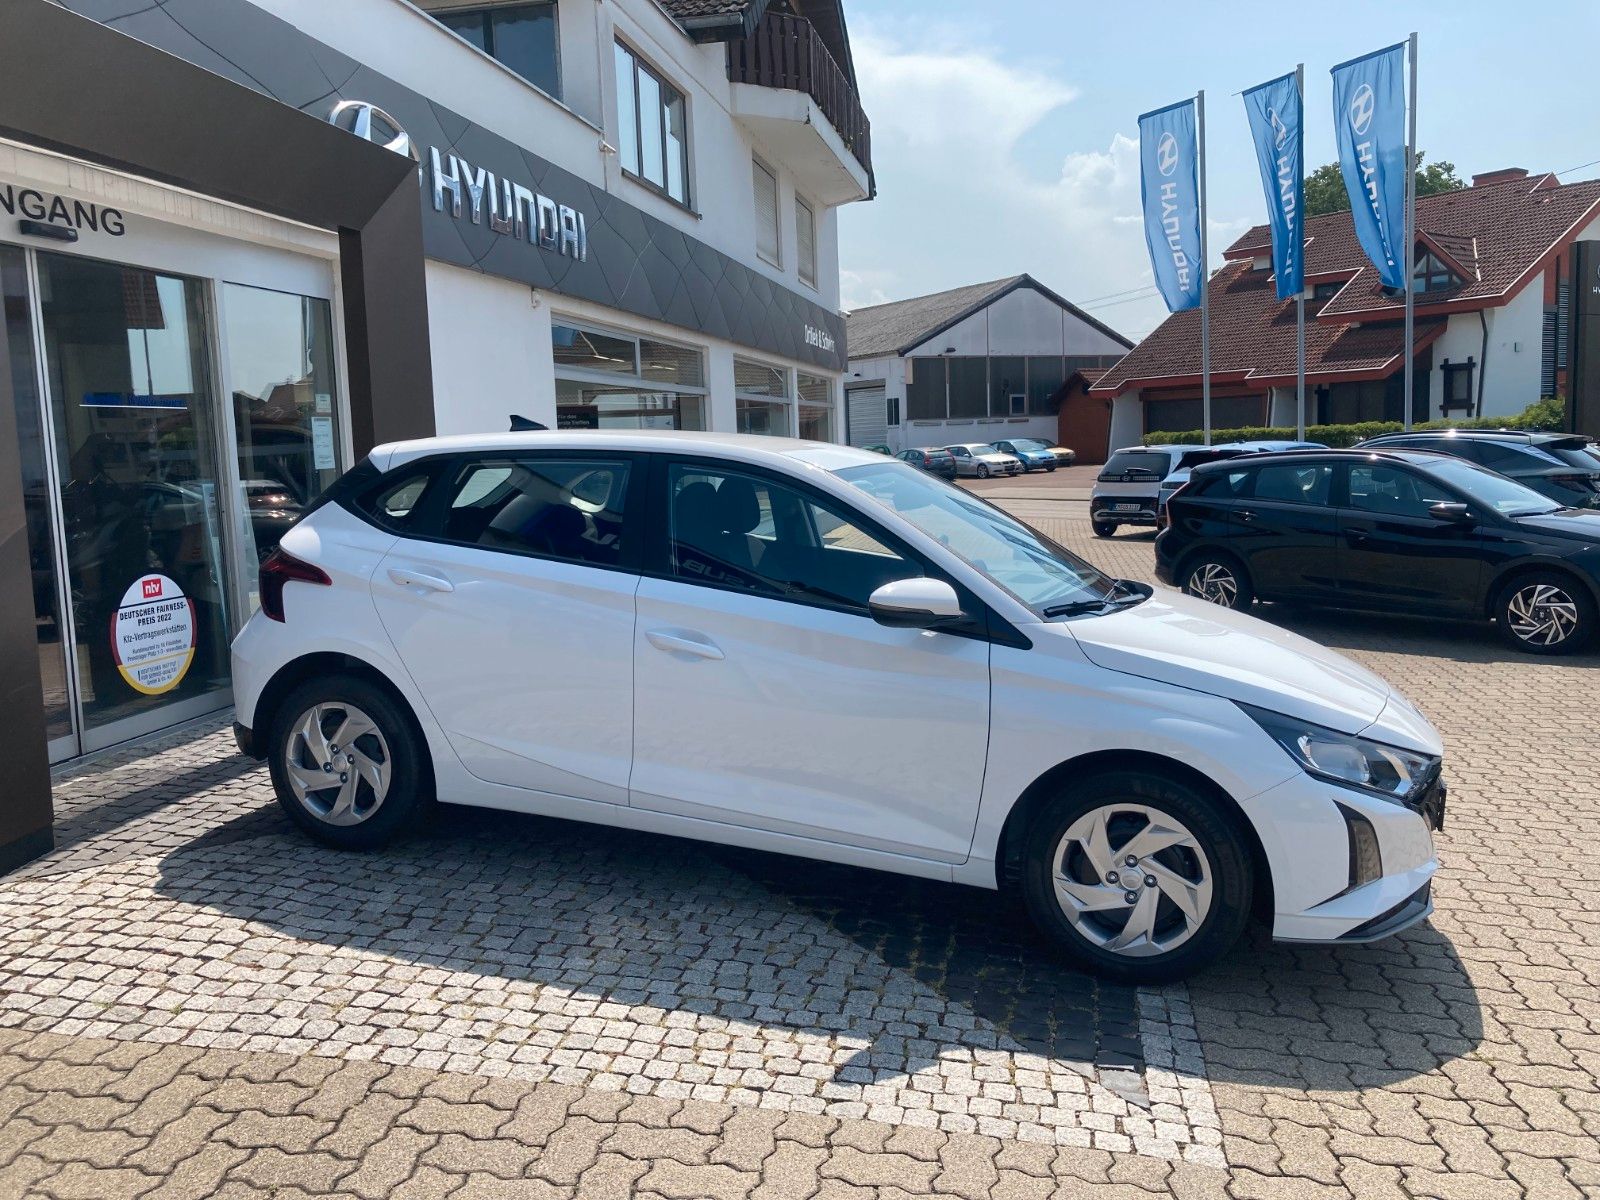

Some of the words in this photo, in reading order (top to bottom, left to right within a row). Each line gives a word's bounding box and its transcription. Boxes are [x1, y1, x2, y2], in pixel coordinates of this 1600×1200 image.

[429, 146, 586, 262] HYUNDAI
[145, 582, 160, 594] ntv
[120, 608, 154, 620] DEUTSCHER
[156, 602, 186, 614] FAIRNESS-
[138, 617, 156, 626] PREIS
[158, 613, 172, 623] 2022
[123, 624, 187, 644] Kfz-Vertragswerkstätten
